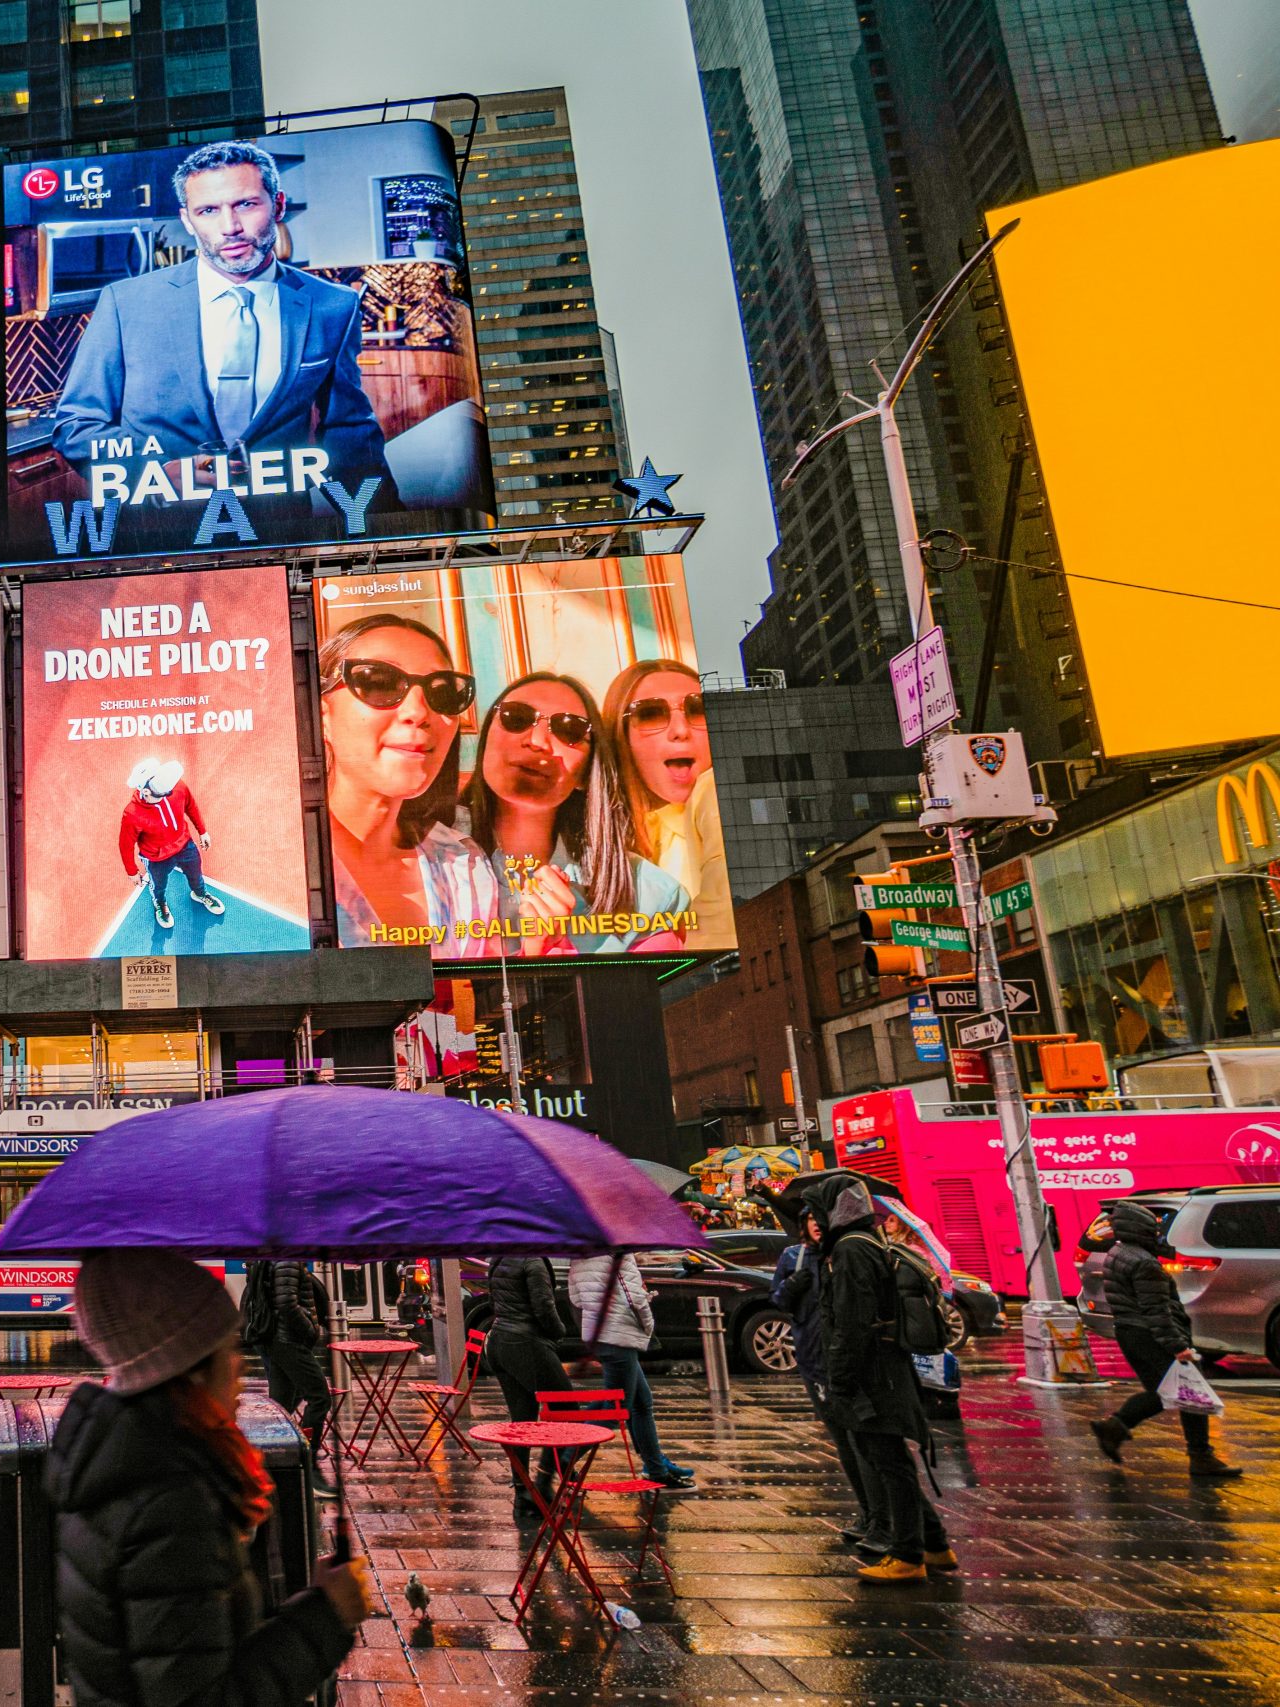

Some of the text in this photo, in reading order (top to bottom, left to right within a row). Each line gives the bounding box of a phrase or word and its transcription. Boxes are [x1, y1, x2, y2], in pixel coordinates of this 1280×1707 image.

[64, 167, 104, 191] LG
[65, 190, 112, 203] Life's Good
[91, 435, 164, 460] I'M A
[91, 447, 332, 508] BALLER
[343, 579, 422, 598] sunglass hut
[101, 601, 212, 640] NEED A
[44, 638, 271, 683] DRONE PILOT?
[894, 641, 942, 681] RIGHT LANE
[907, 671, 936, 704] MUST
[100, 695, 211, 711] SCHEDULE A MISSION AT
[903, 692, 952, 732] TURN RIGHT
[67, 708, 254, 742] ZEKEDRONE.COM
[878, 886, 954, 908] Broadway
[992, 882, 1030, 915] W 45 St
[370, 910, 698, 945] Happy #GALENTINESDAY!!
[896, 922, 968, 943] George Abbott
[928, 940, 940, 948] Way
[126, 964, 171, 975] EVEREST
[946, 992, 977, 1005] ONE
[964, 1020, 999, 1041] ONE WAY
[534, 1089, 588, 1117] hut
[1064, 1132, 1136, 1147] gets fed!
[1110, 1151, 1128, 1161] to
[0, 1271, 75, 1283] WINDSORS
